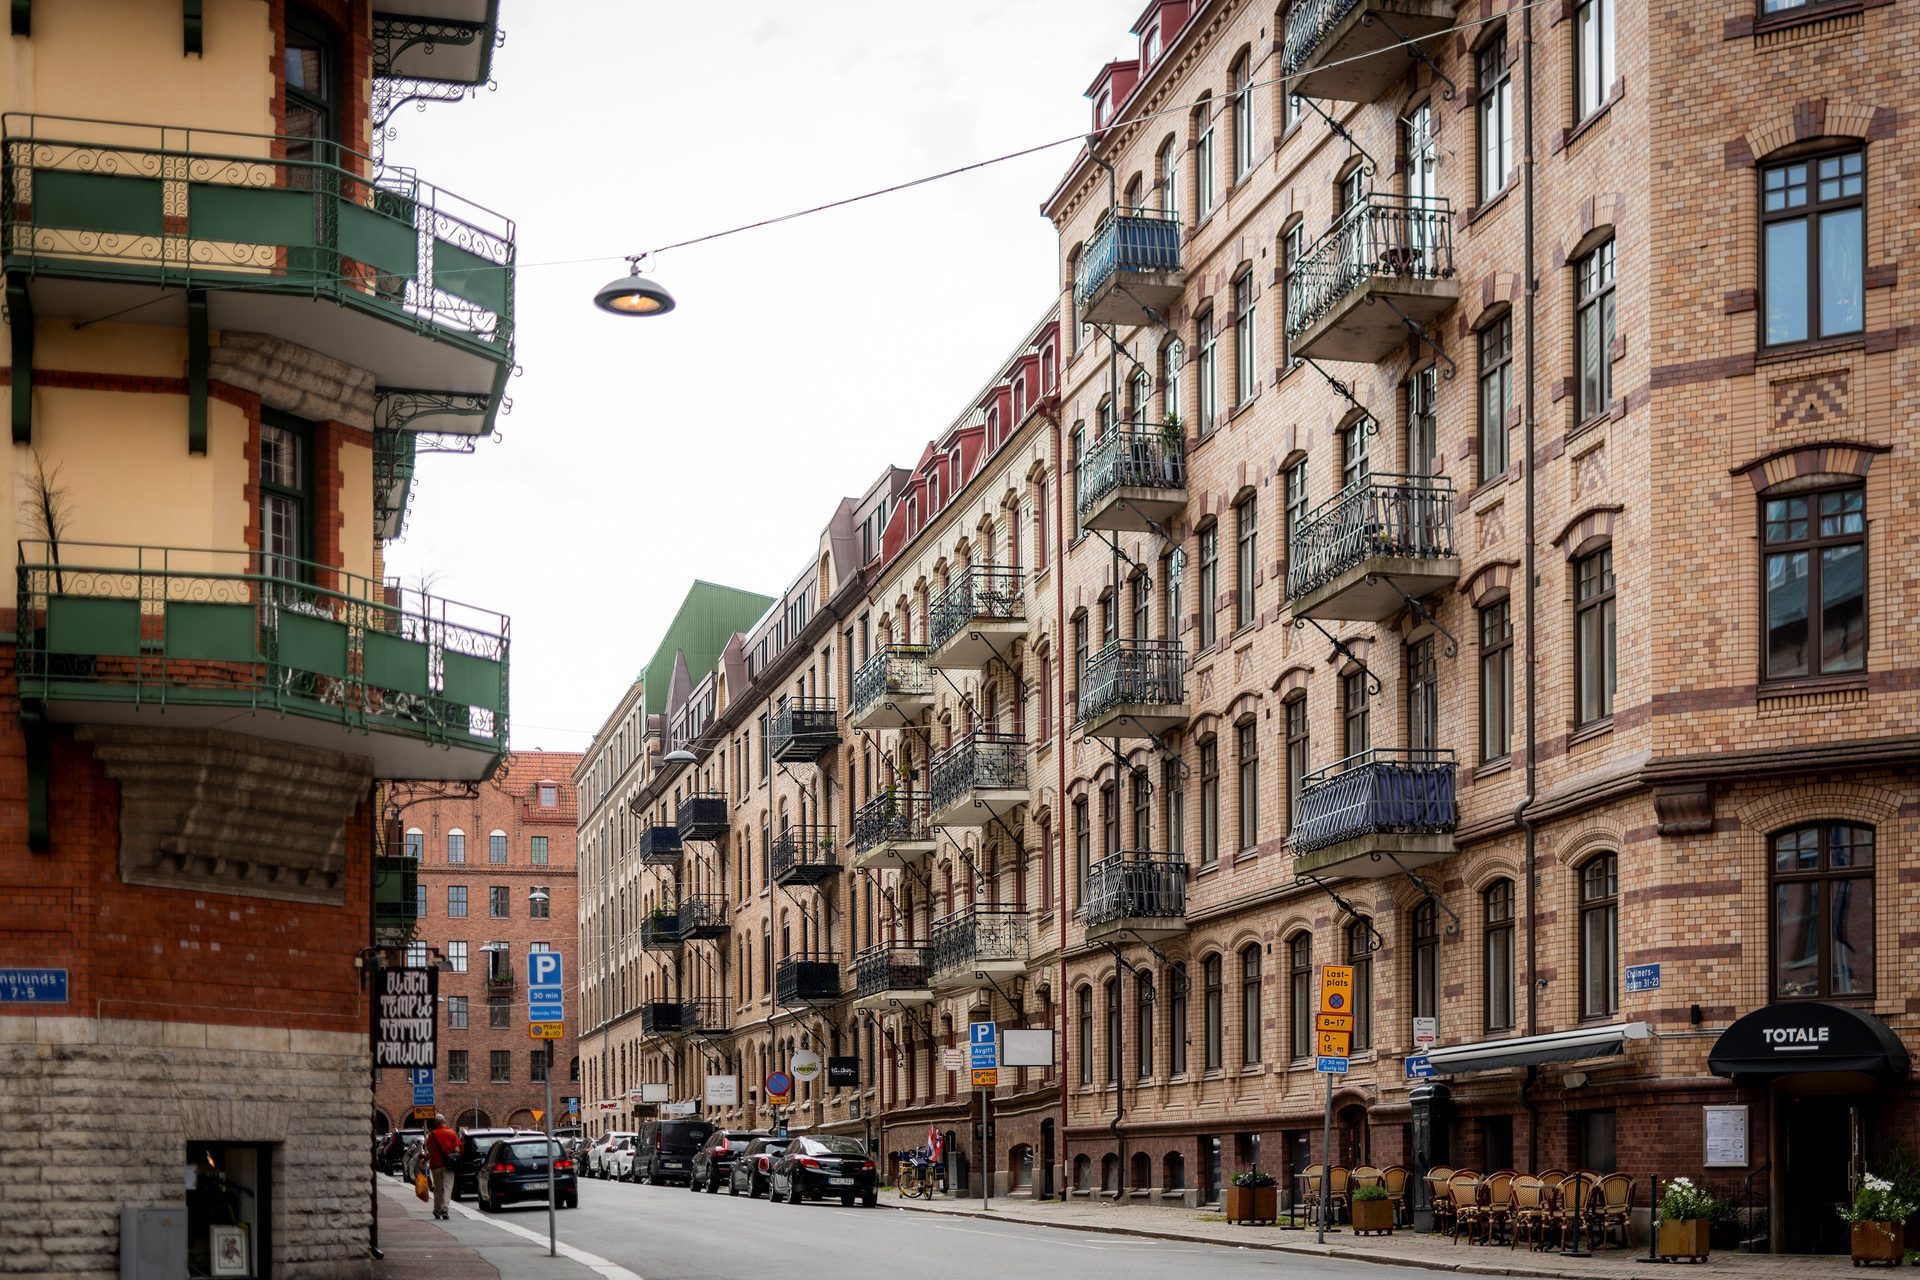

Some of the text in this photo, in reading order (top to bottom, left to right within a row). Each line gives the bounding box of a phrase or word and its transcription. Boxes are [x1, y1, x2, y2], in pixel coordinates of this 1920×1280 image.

[537, 955, 556, 983] P
[1326, 970, 1349, 978] Last-
[1626, 969, 1654, 979] Chalmers-
[1326, 979, 1349, 988] plats
[1643, 977, 1659, 988] 31-23
[11, 987, 36, 998] 7-5
[380, 995, 433, 1018] TEMPLE
[1323, 1018, 1345, 1027] 8-17
[978, 1025, 989, 1042] P
[1763, 1027, 1829, 1043] TOTALE
[377, 1041, 434, 1065] PARLOUR
[1323, 1044, 1332, 1052] 15
[418, 1069, 430, 1084] P
